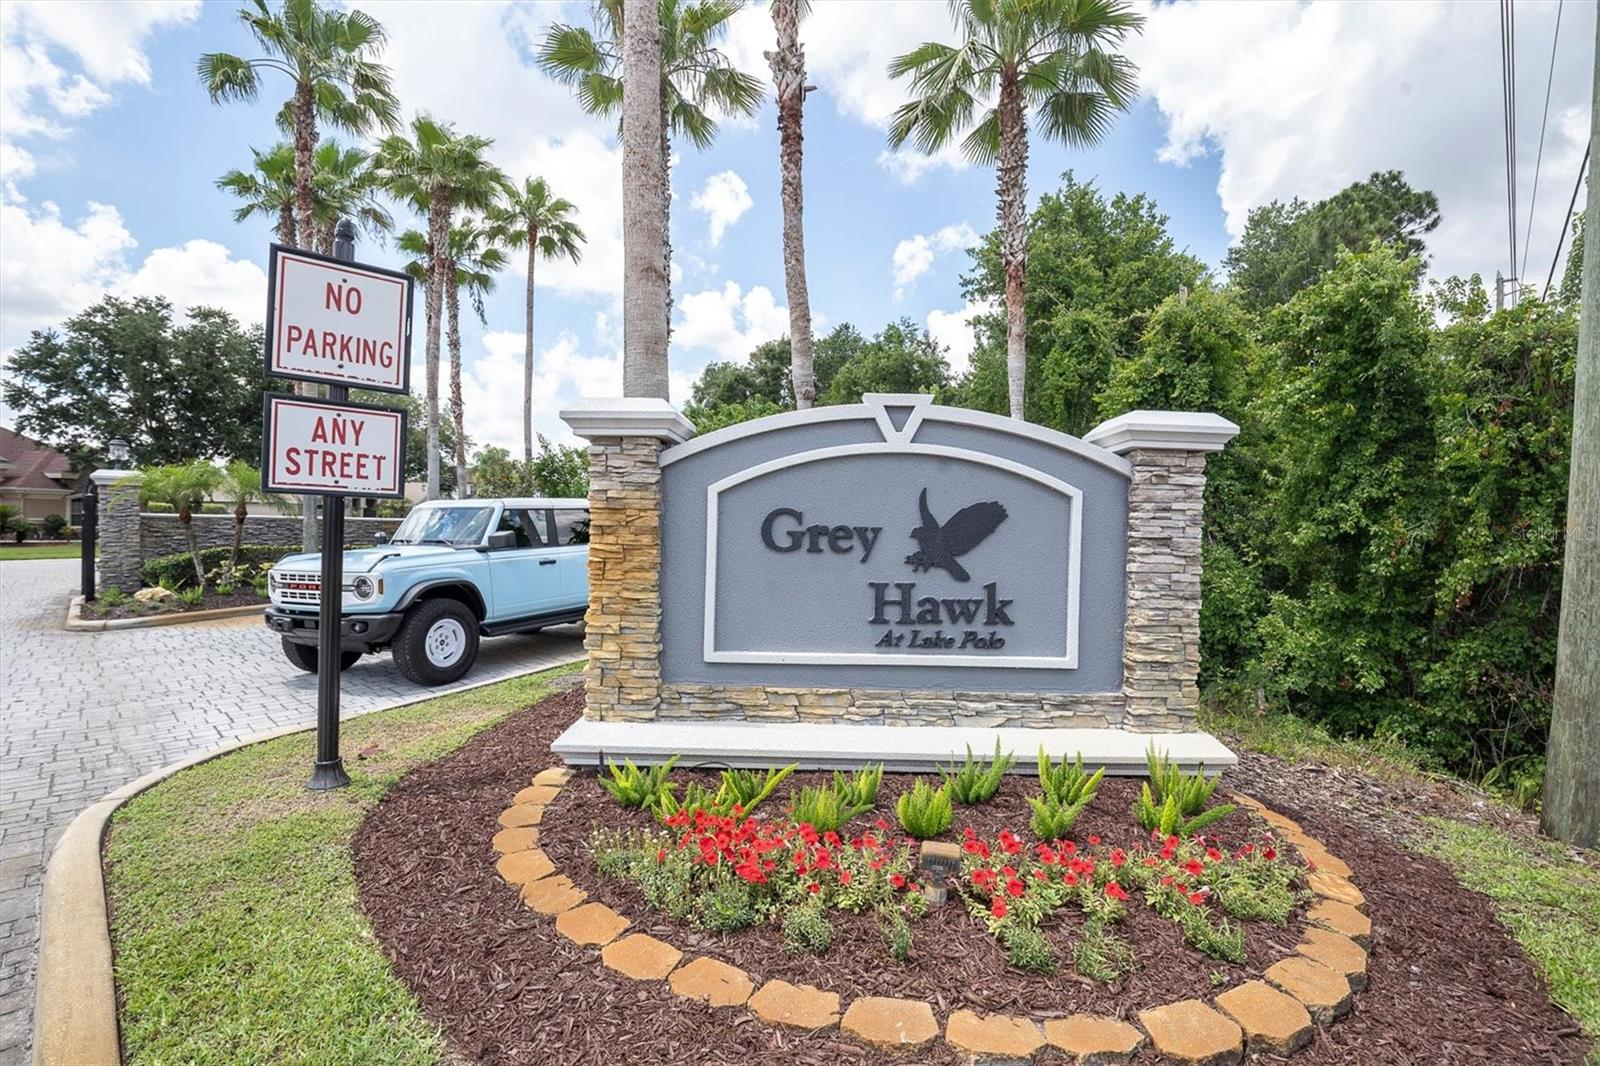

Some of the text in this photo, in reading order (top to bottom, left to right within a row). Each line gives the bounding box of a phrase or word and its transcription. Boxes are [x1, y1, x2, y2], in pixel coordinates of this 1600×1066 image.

[325, 281, 362, 315] NO
[286, 325, 393, 369] PARKING
[311, 416, 365, 446] ANY
[285, 447, 386, 480] STREET
[760, 507, 882, 563] Grey
[290, 583, 321, 591] FOR
[868, 582, 1015, 626] Hawk
[875, 629, 1006, 650] At Lake Polo
